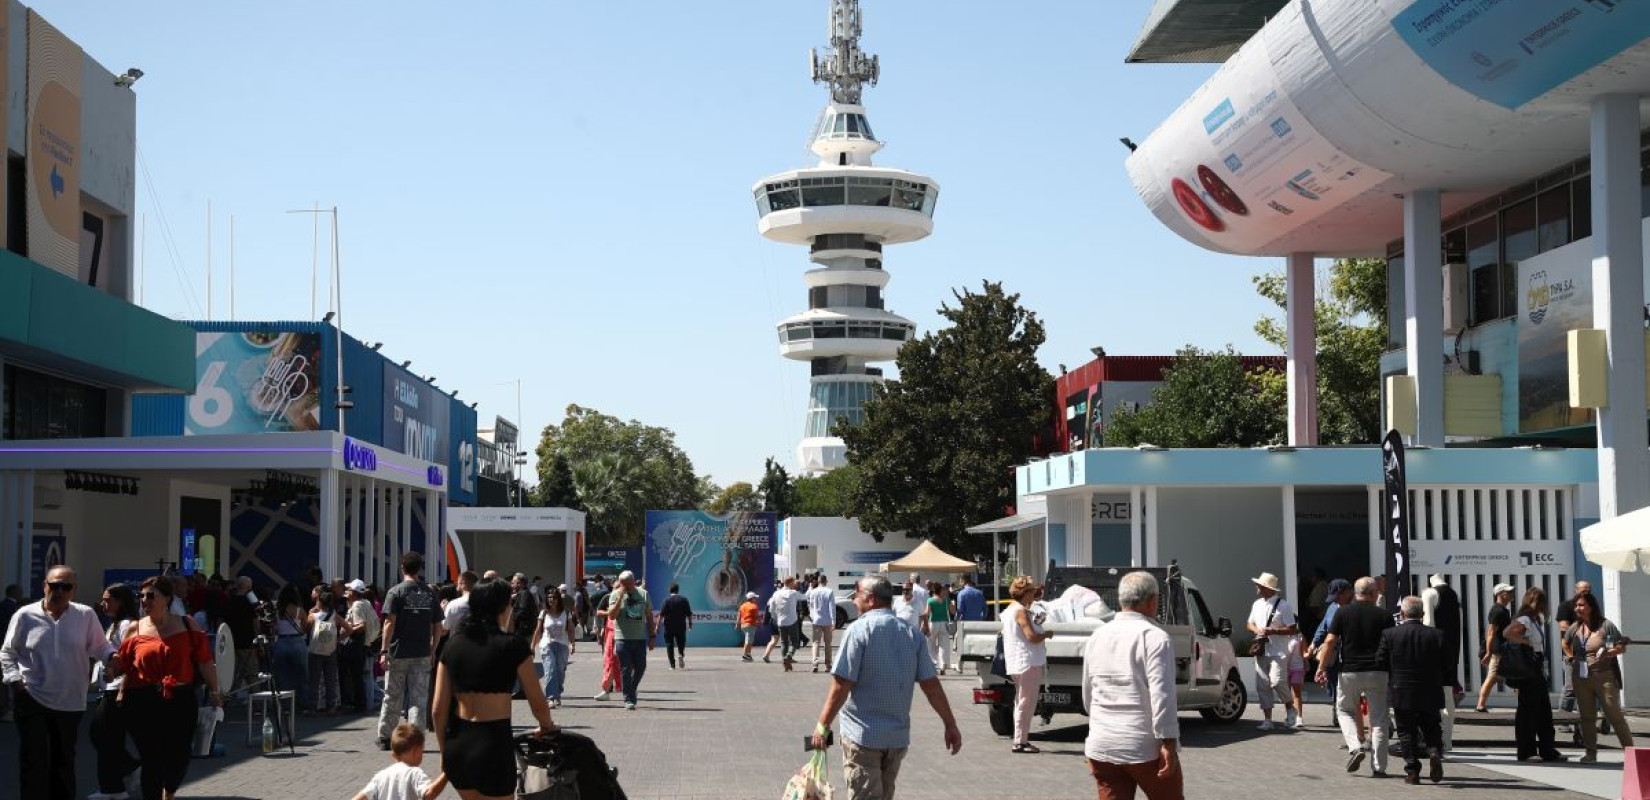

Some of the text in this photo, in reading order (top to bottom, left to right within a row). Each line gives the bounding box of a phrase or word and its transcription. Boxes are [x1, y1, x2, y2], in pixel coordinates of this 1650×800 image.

[83, 211, 103, 287] 7
[189, 362, 232, 433] 6
[459, 440, 474, 494] 12
[741, 535, 770, 543] GREECE
[745, 542, 770, 550] TASTES
[1535, 553, 1555, 562] ECG
